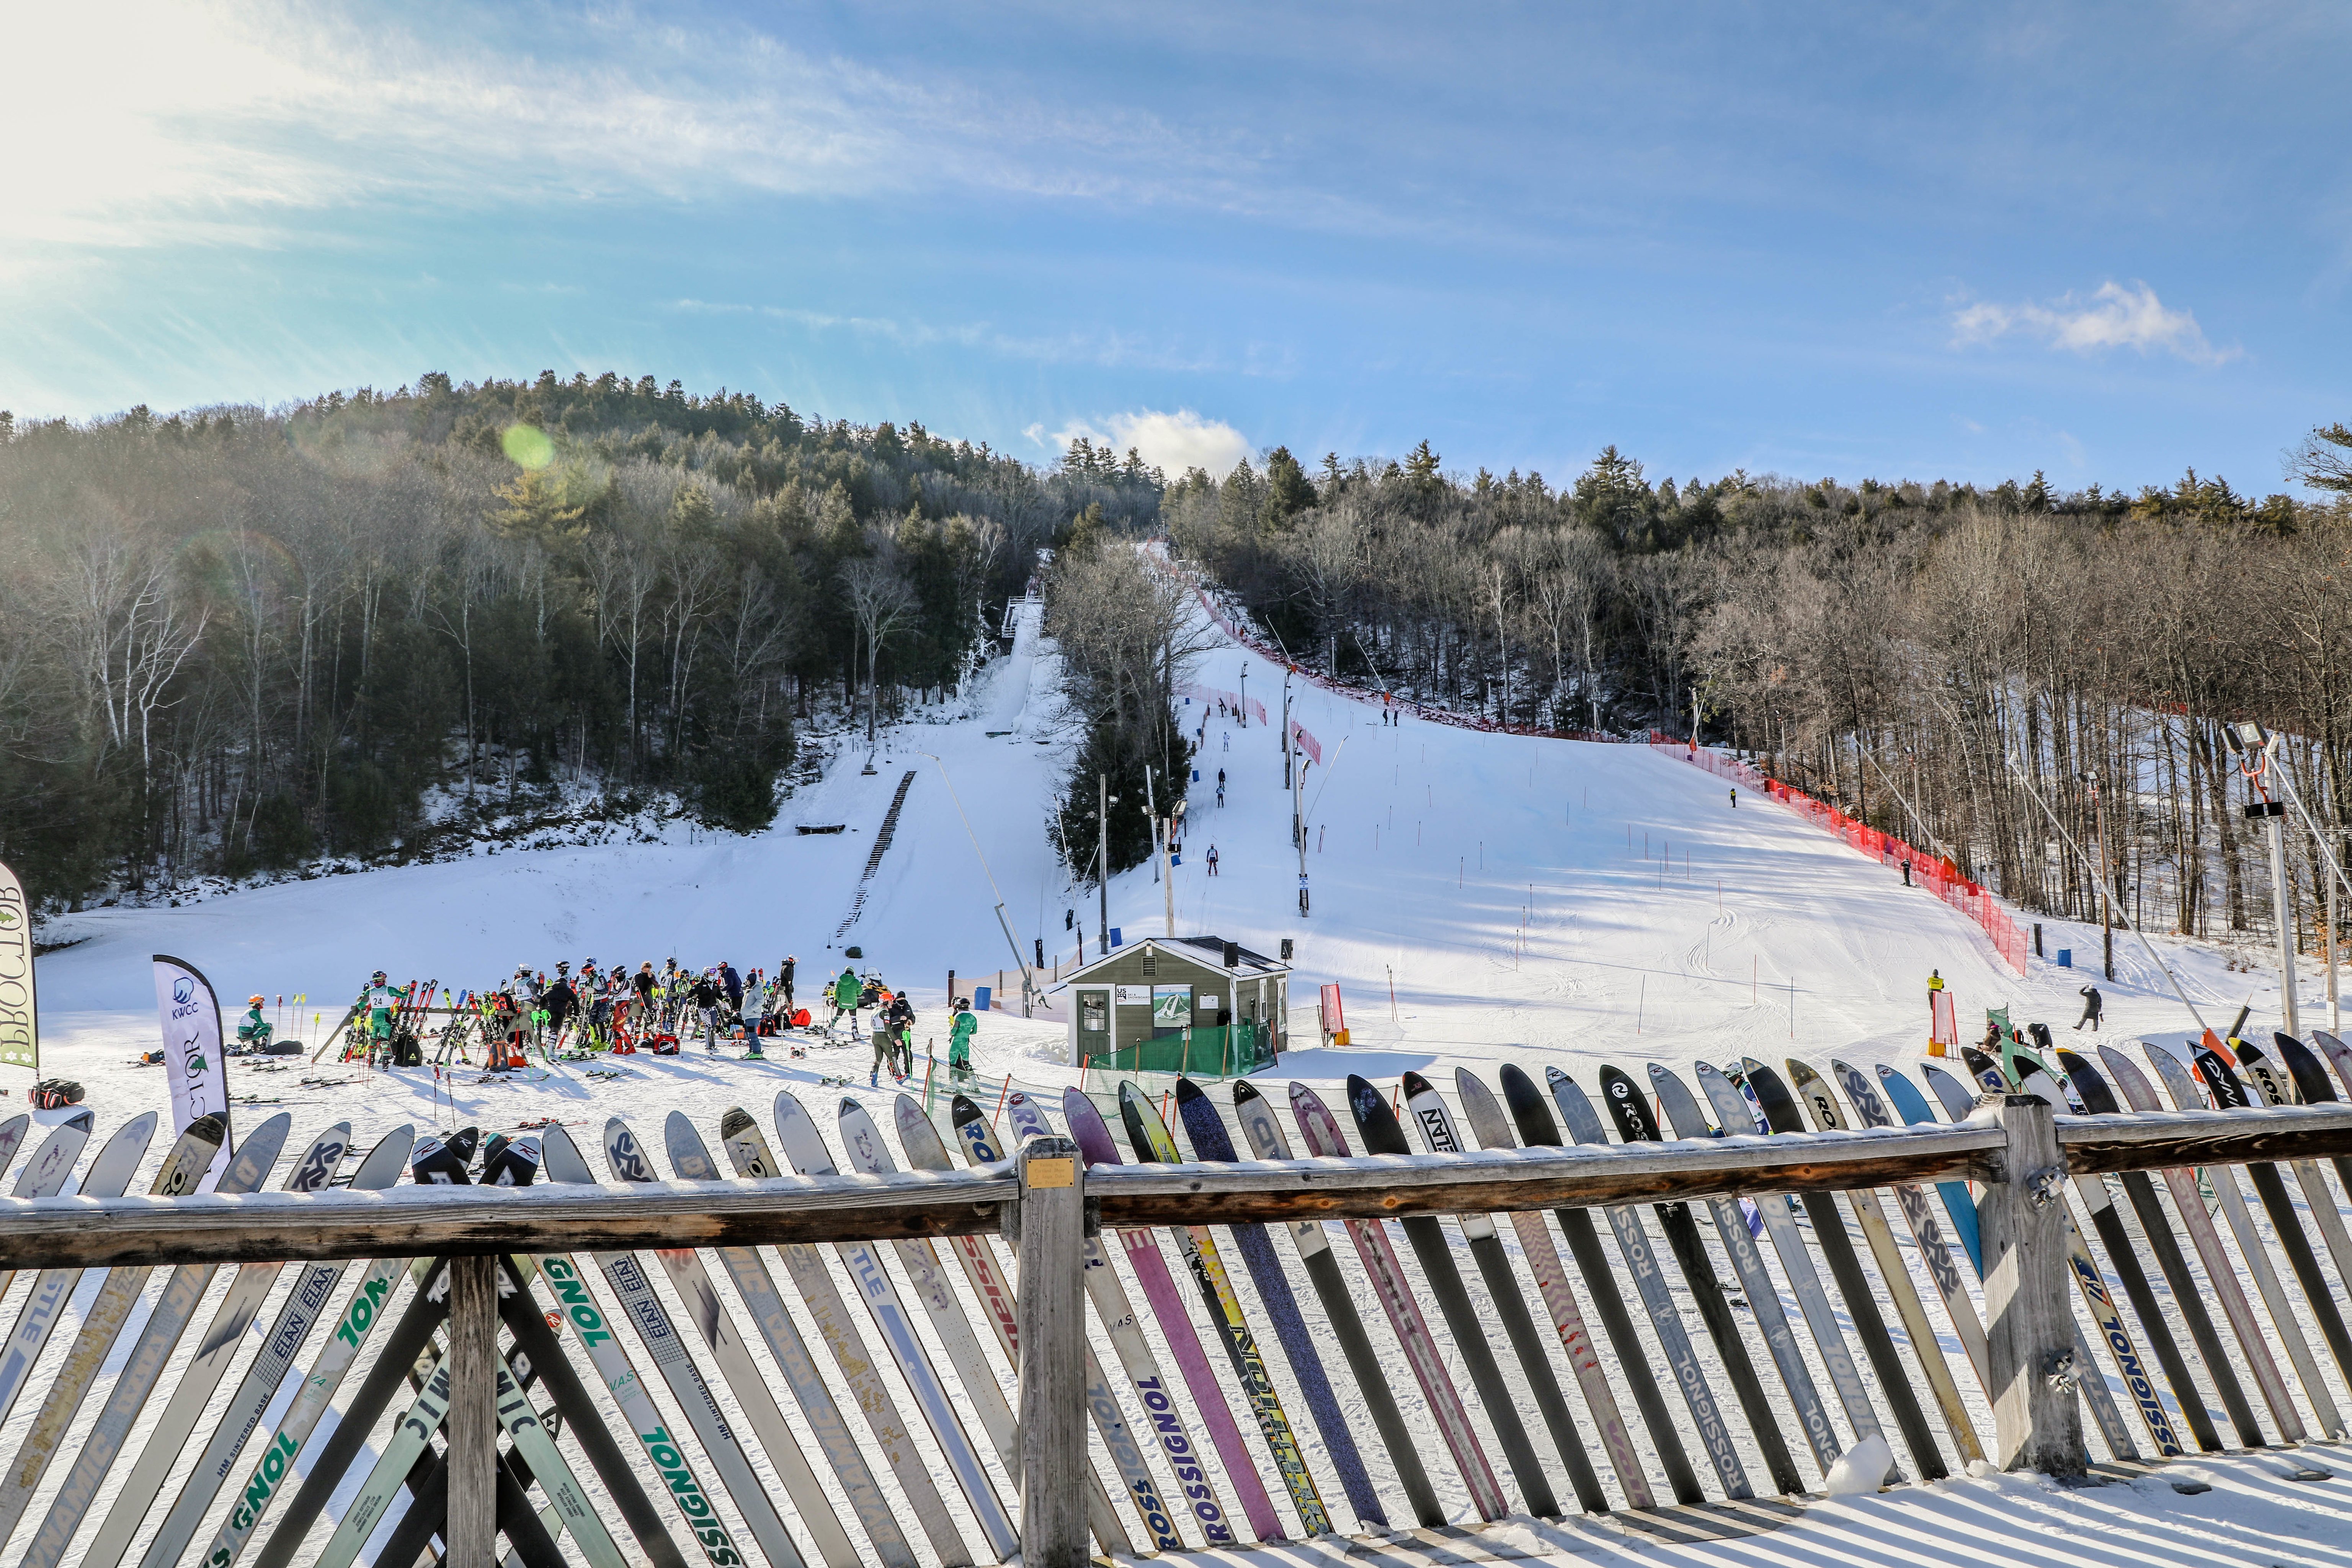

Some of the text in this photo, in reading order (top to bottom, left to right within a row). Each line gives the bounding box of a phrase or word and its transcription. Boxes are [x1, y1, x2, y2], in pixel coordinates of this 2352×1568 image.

[172, 1002, 198, 1021] KWCC
[1199, 1255, 1210, 1281] DUAL
[274, 1313, 305, 1360] ELAN
[637, 1300, 668, 1339] ELAN
[609, 1369, 636, 1392] V.A.S.
[685, 1363, 730, 1441] HM SINTERED BASE
[1678, 1350, 1744, 1490] ROSSIGNOL
[217, 1392, 270, 1478] HM SINTERED BASE
[1137, 1375, 1232, 1542] ROSSIGNOL
[352, 1495, 371, 1523] BEVELLED EDGES
[357, 1495, 382, 1533] MICRO STONE GROUND
[557, 1493, 575, 1517] BEVELLED EDGES
[562, 1482, 585, 1517] MICRO STONE GROUND
[565, 1496, 579, 1516] STRUCTURED
[640, 1426, 745, 1568] SSIGNOL
[356, 1505, 370, 1527] STRUCTURED
